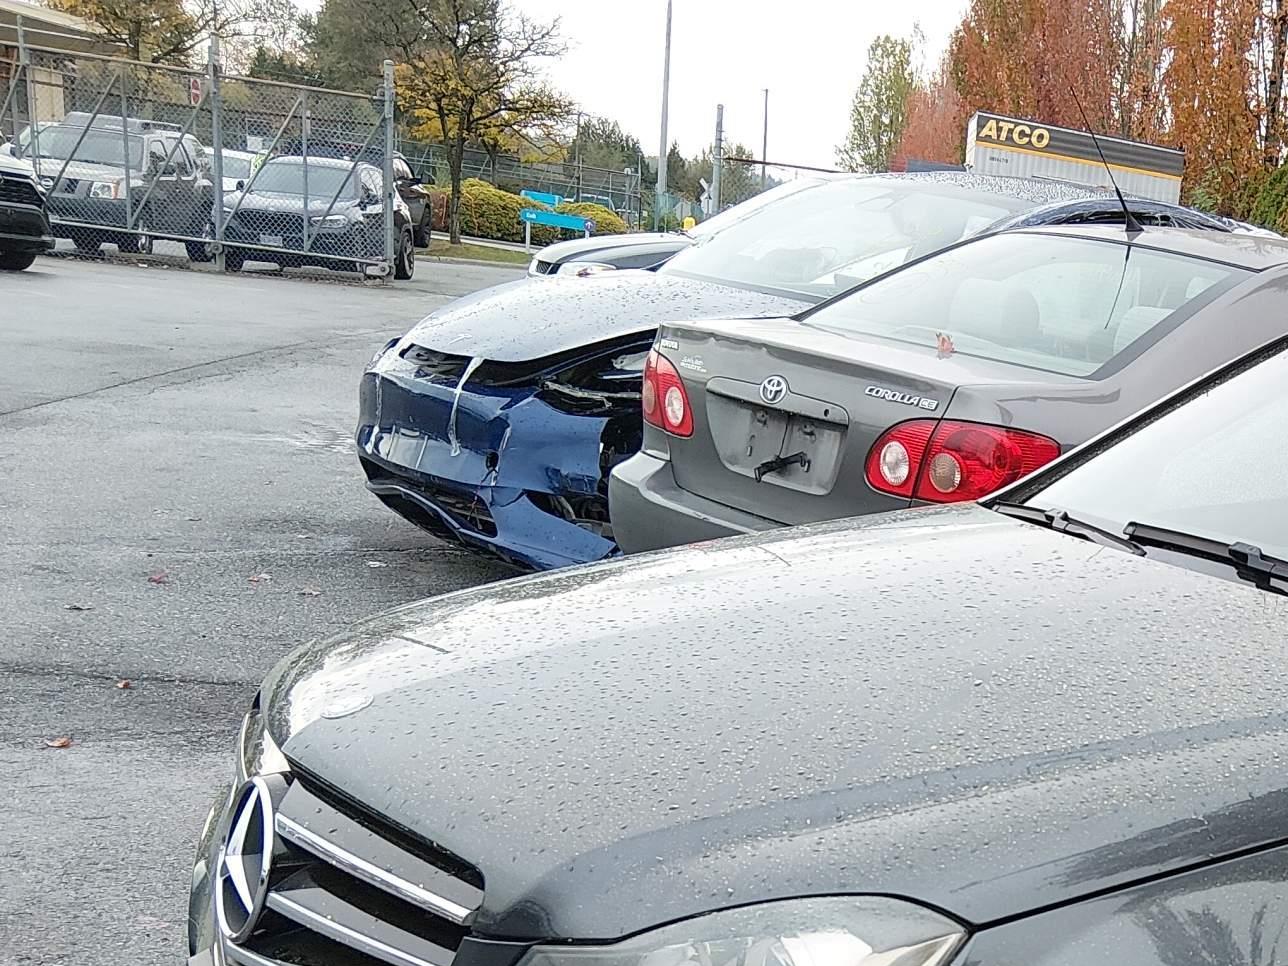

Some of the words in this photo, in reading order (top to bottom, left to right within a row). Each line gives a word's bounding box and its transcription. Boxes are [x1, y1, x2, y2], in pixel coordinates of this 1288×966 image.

[978, 119, 1050, 148] ATCO
[865, 386, 920, 406] COROLLA
[920, 398, 937, 410] CE
